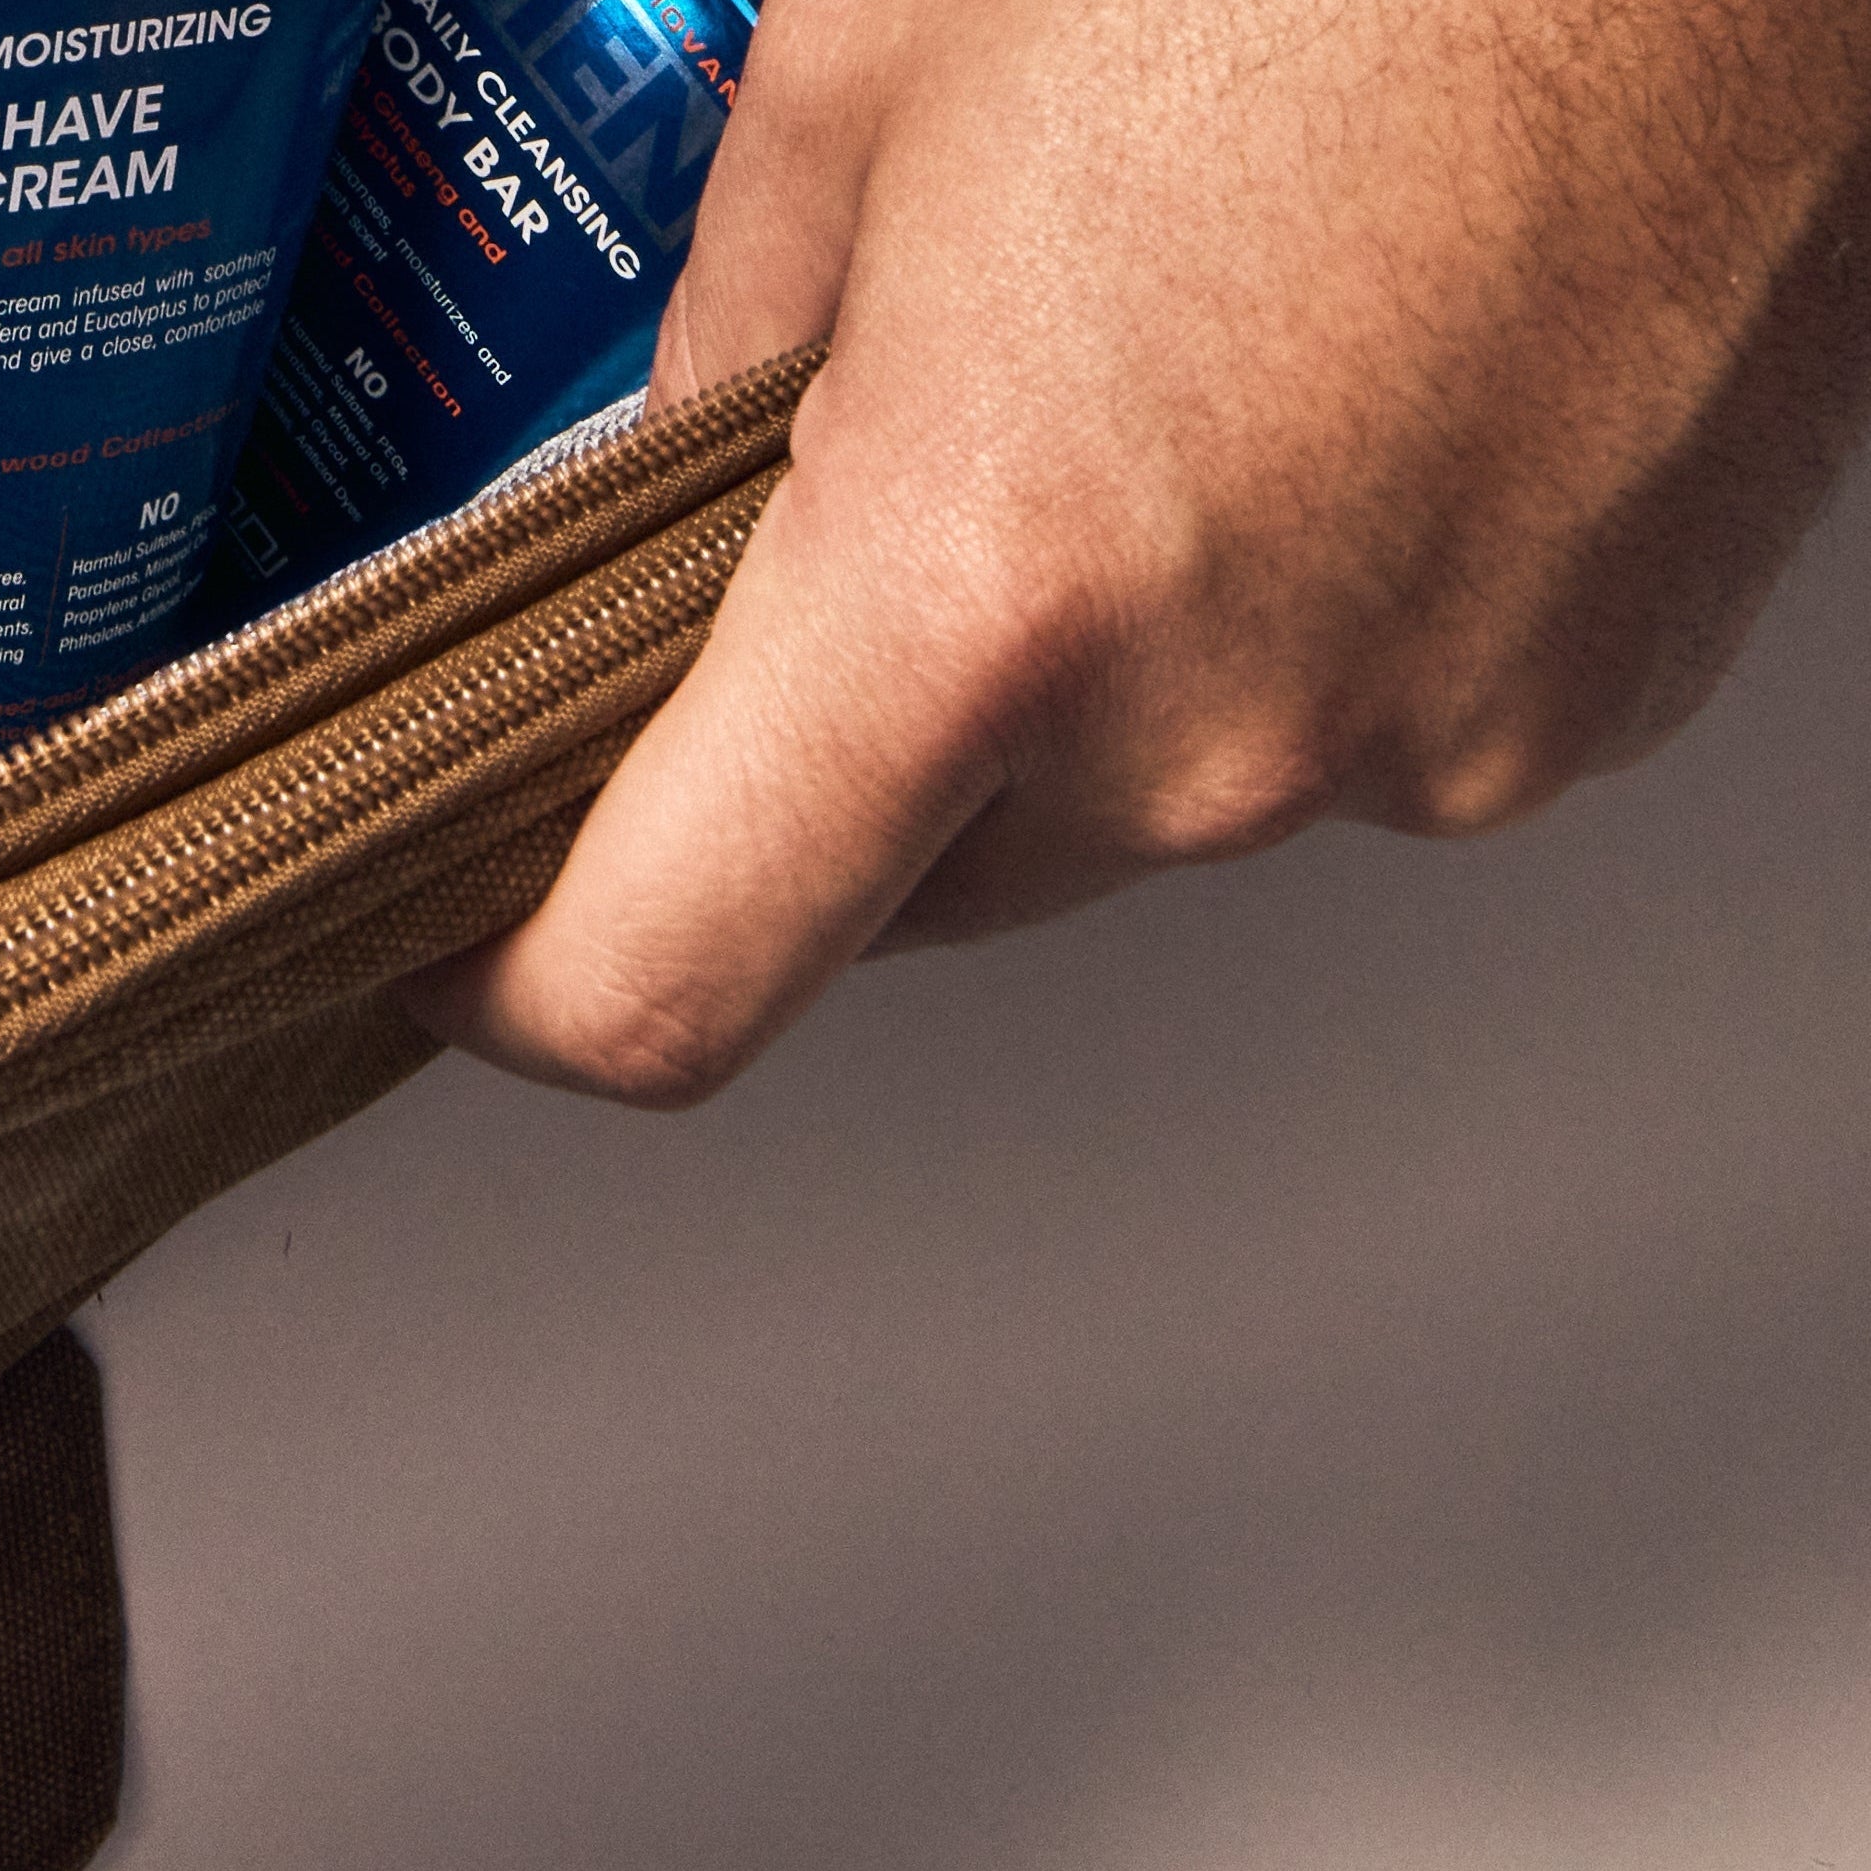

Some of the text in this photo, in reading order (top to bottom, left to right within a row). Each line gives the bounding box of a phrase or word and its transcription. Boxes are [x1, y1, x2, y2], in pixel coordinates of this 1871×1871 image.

[373, 90, 461, 208] Ginseng
[457, 208, 509, 265] and
[463, 136, 550, 245] BAR
[475, 70, 641, 281] CLEANSING
[1, 240, 43, 268] all
[53, 233, 117, 262] skin
[127, 218, 212, 254] types
[348, 214, 389, 262] scent
[38, 315, 78, 340] and
[83, 299, 187, 333] Eucalyptus
[193, 293, 211, 311] to
[214, 270, 272, 310] protect
[72, 276, 146, 307] infused
[155, 268, 194, 293] with
[203, 246, 277, 283] soothing
[30, 347, 72, 373] give
[80, 344, 94, 361] a
[164, 299, 265, 345] comfortable
[395, 237, 512, 387] moisturizes and
[344, 346, 389, 399] NO
[353, 272, 463, 419] Collection
[139, 491, 180, 530] NO
[71, 546, 133, 576] Harmful
[63, 595, 139, 628] Propylene
